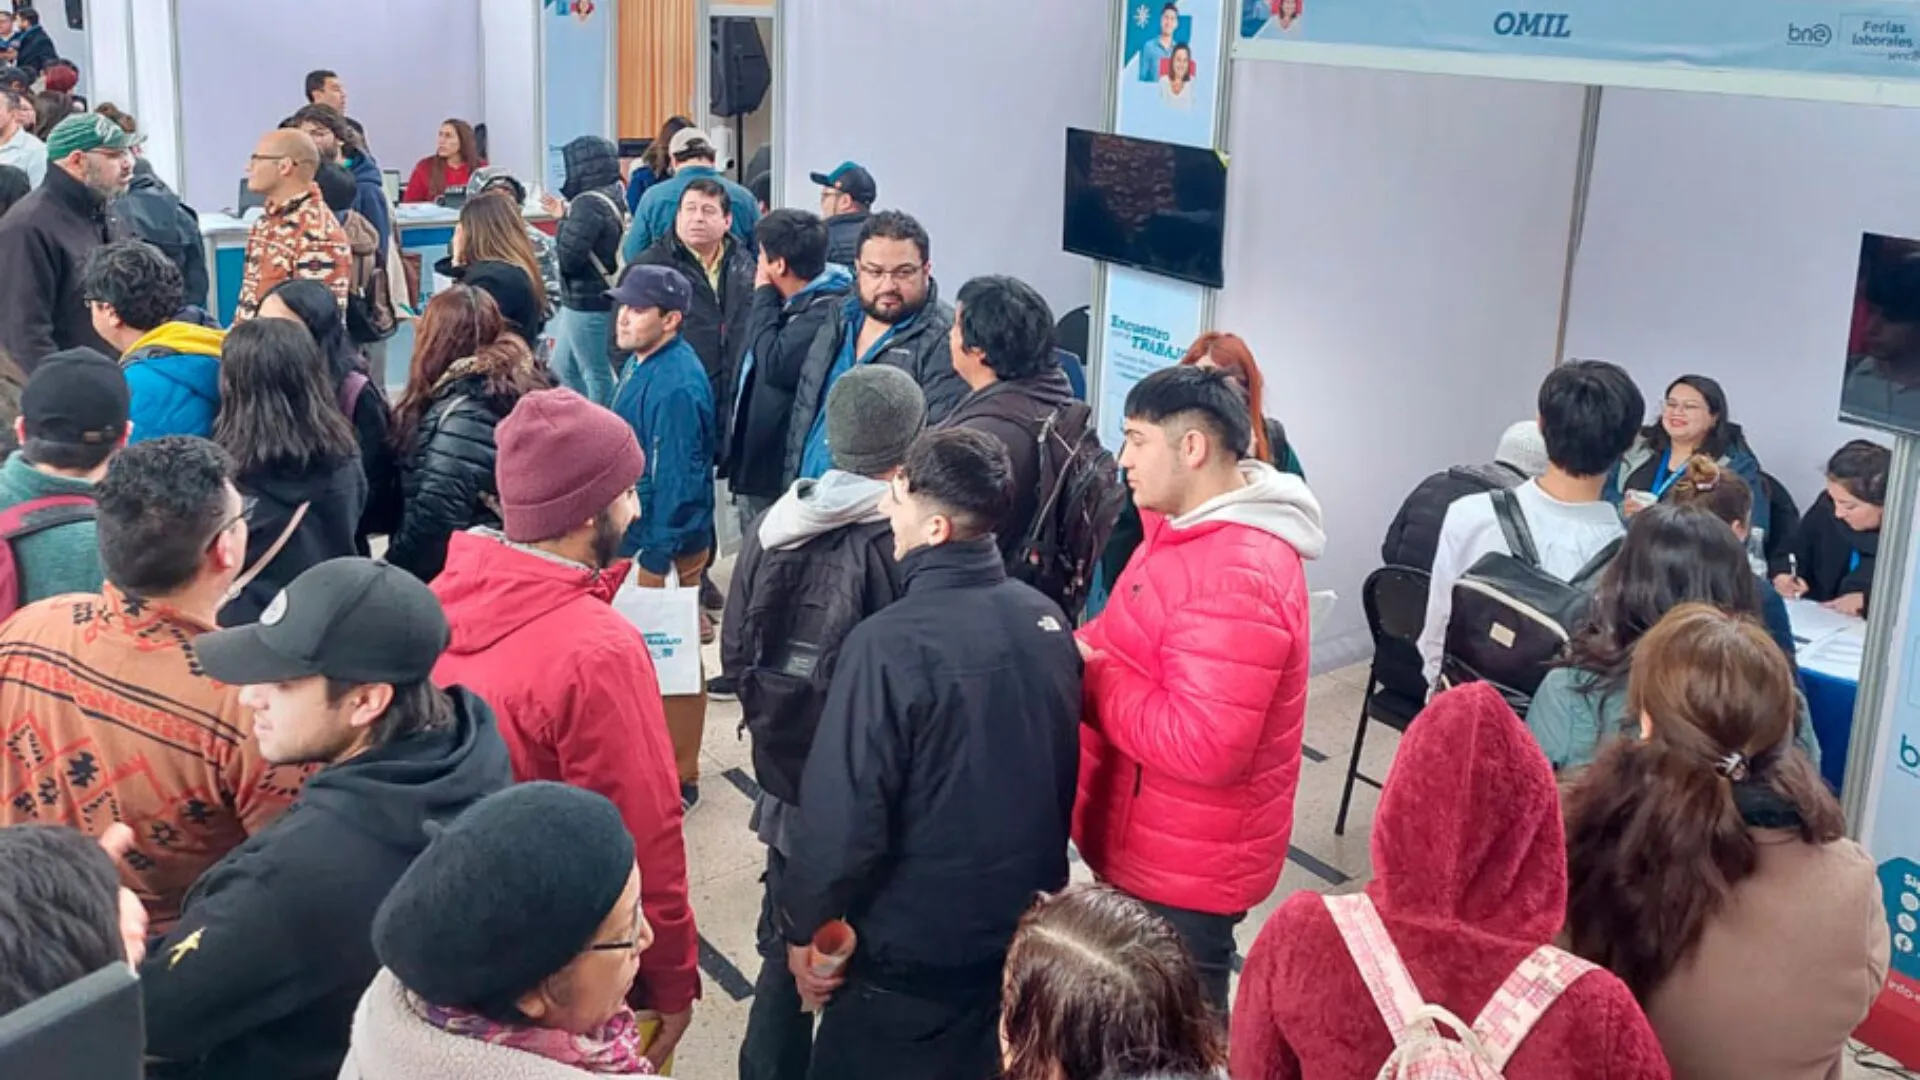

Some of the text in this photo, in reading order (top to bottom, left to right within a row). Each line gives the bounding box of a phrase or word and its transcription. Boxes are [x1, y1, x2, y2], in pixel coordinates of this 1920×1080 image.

[1493, 11, 1572, 38] OMIL
[1786, 22, 1832, 47] bne
[1862, 20, 1906, 34] Ferias
[1851, 33, 1913, 48] laborales
[1111, 314, 1170, 341] Encuentro
